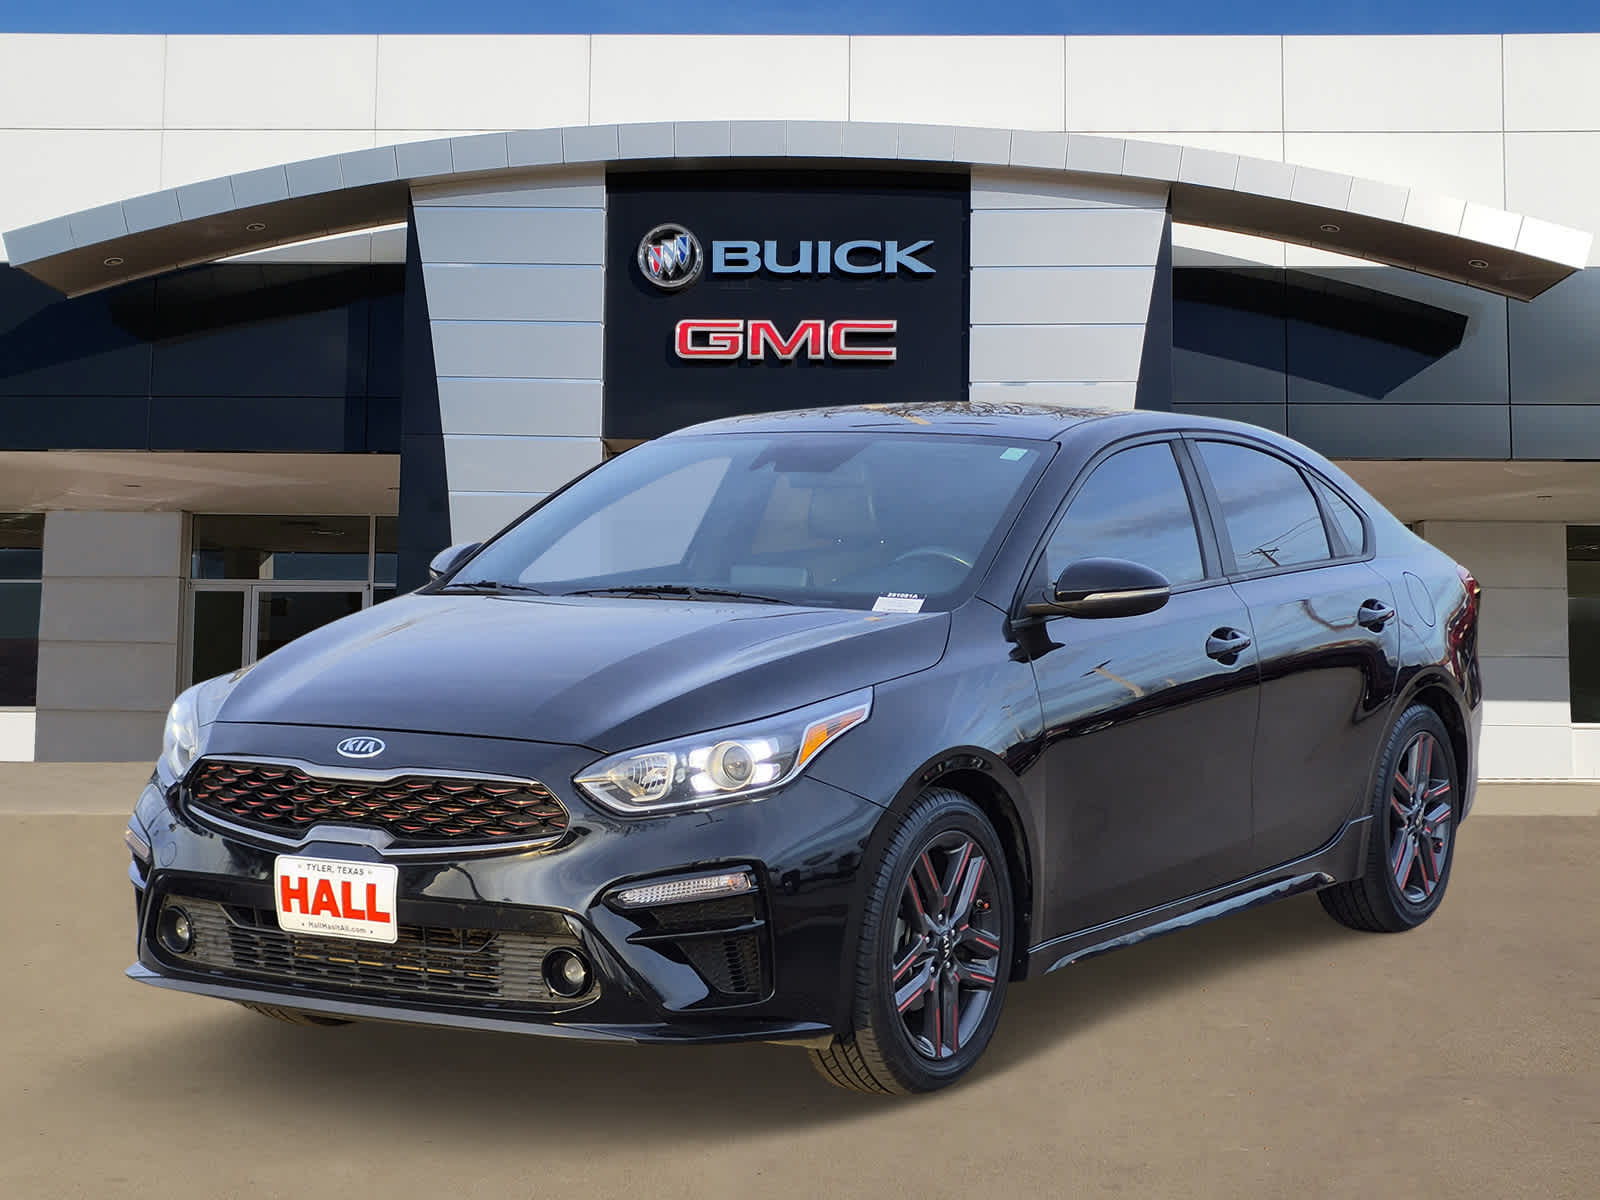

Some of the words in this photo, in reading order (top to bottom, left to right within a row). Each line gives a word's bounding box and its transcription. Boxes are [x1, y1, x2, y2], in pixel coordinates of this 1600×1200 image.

[712, 240, 936, 273] BUICK
[675, 319, 897, 360] GMC
[343, 740, 375, 752] KIA
[337, 866, 364, 876] TEXAS
[280, 875, 391, 923] HALL
